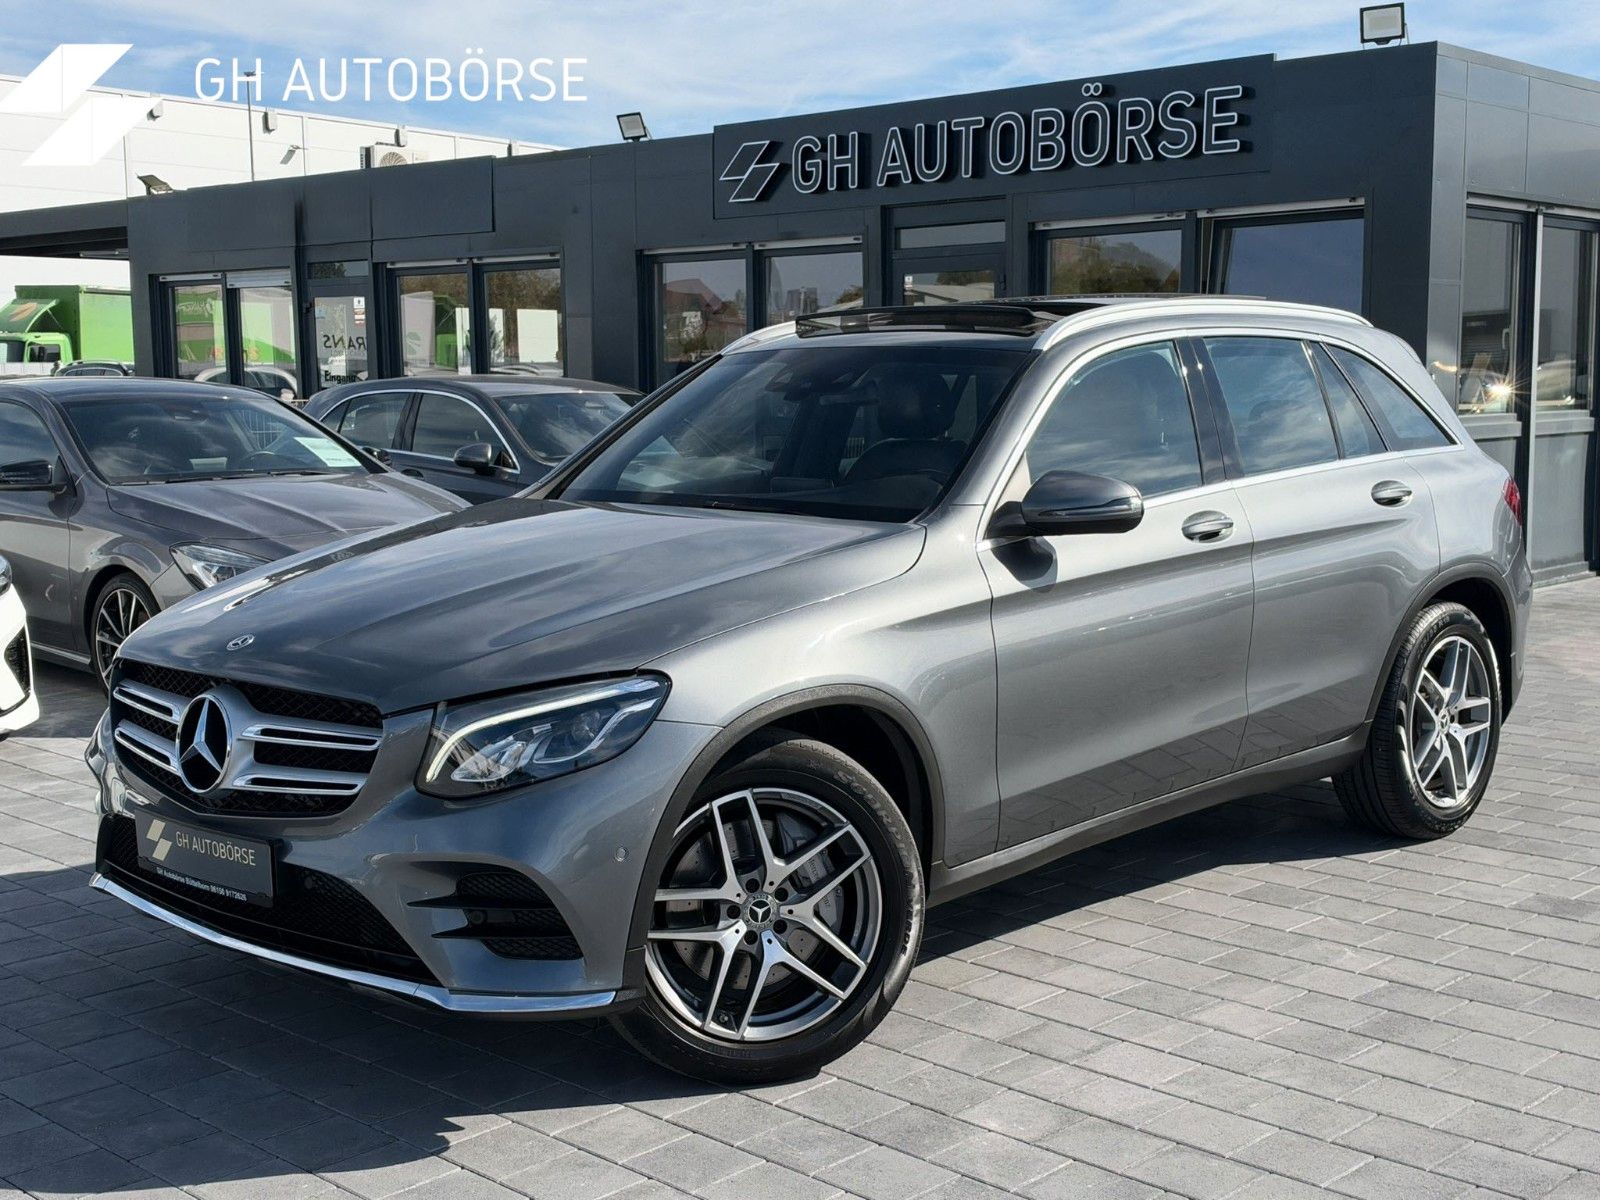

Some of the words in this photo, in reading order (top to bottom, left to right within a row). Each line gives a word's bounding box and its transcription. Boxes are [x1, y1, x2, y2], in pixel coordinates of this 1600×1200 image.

[792, 131, 858, 193] GH
[877, 82, 1243, 186] AUTOBÖRSE
[176, 831, 189, 849] GH
[192, 836, 256, 866] AUTOBÖRSE
